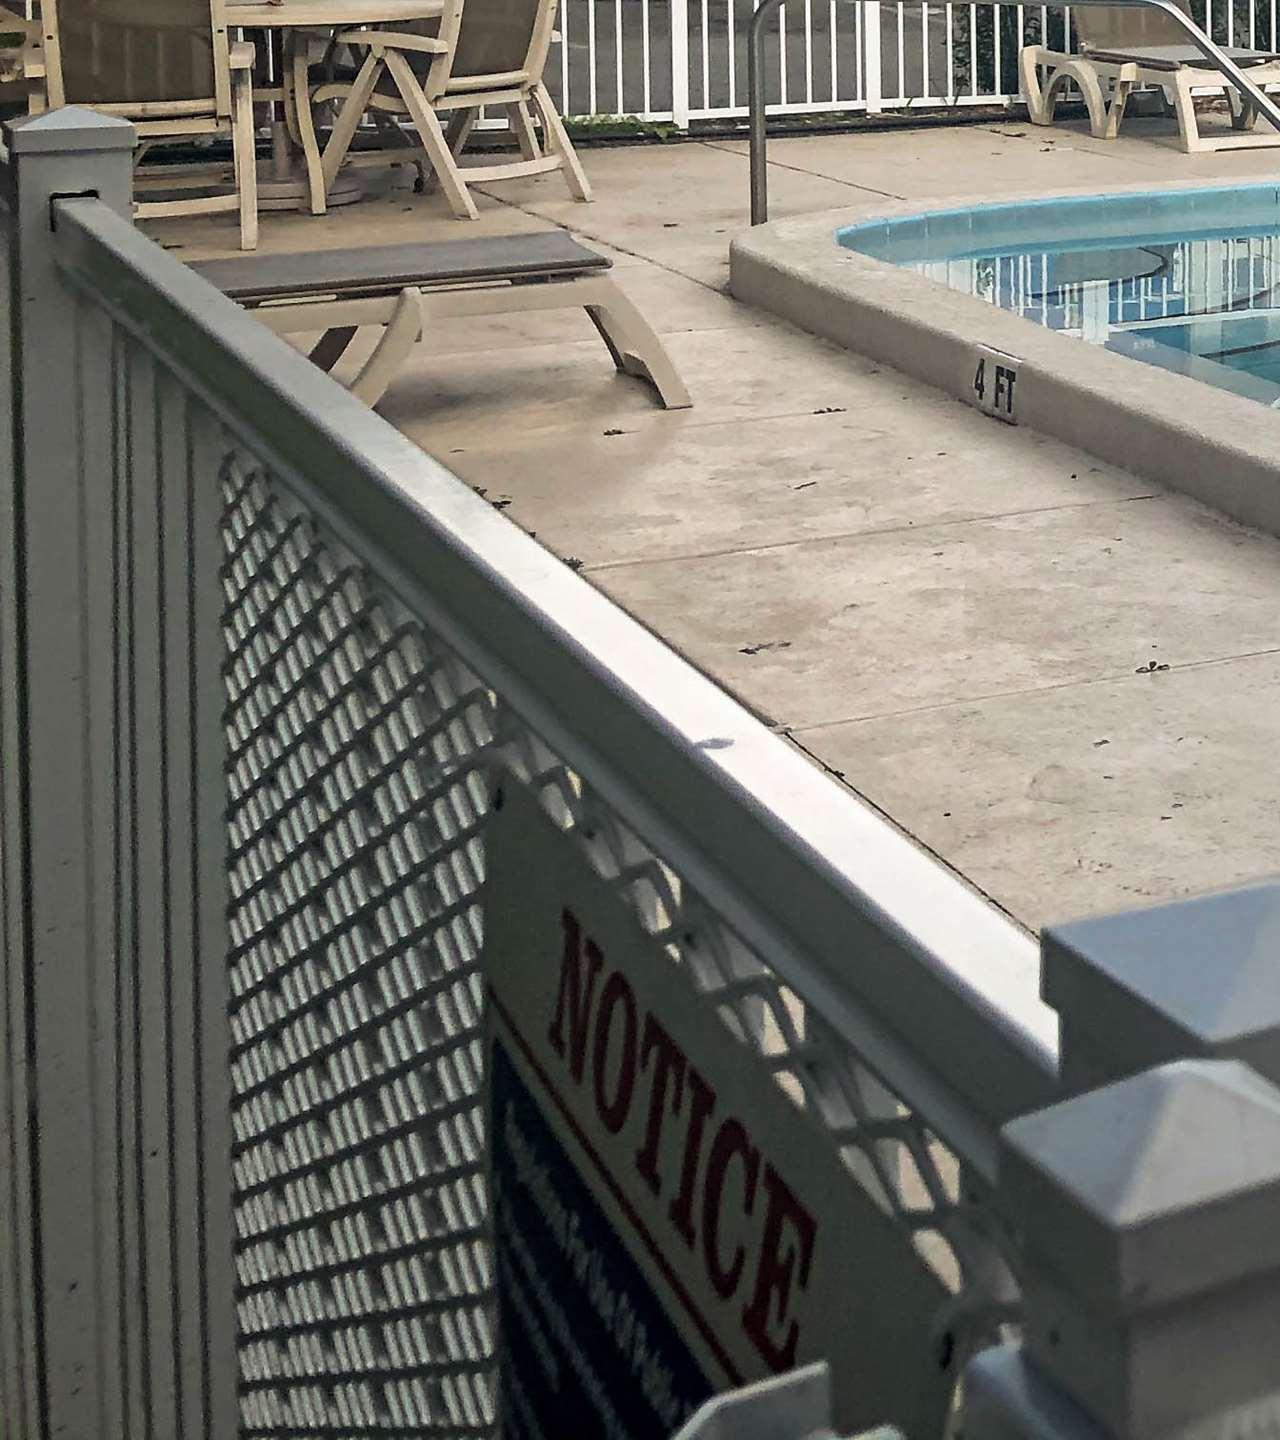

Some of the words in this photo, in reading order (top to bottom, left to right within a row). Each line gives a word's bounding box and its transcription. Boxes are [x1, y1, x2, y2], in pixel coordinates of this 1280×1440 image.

[974, 358, 985, 400] 4
[995, 365, 1016, 413] FT
[548, 907, 818, 1371] NOTICE
